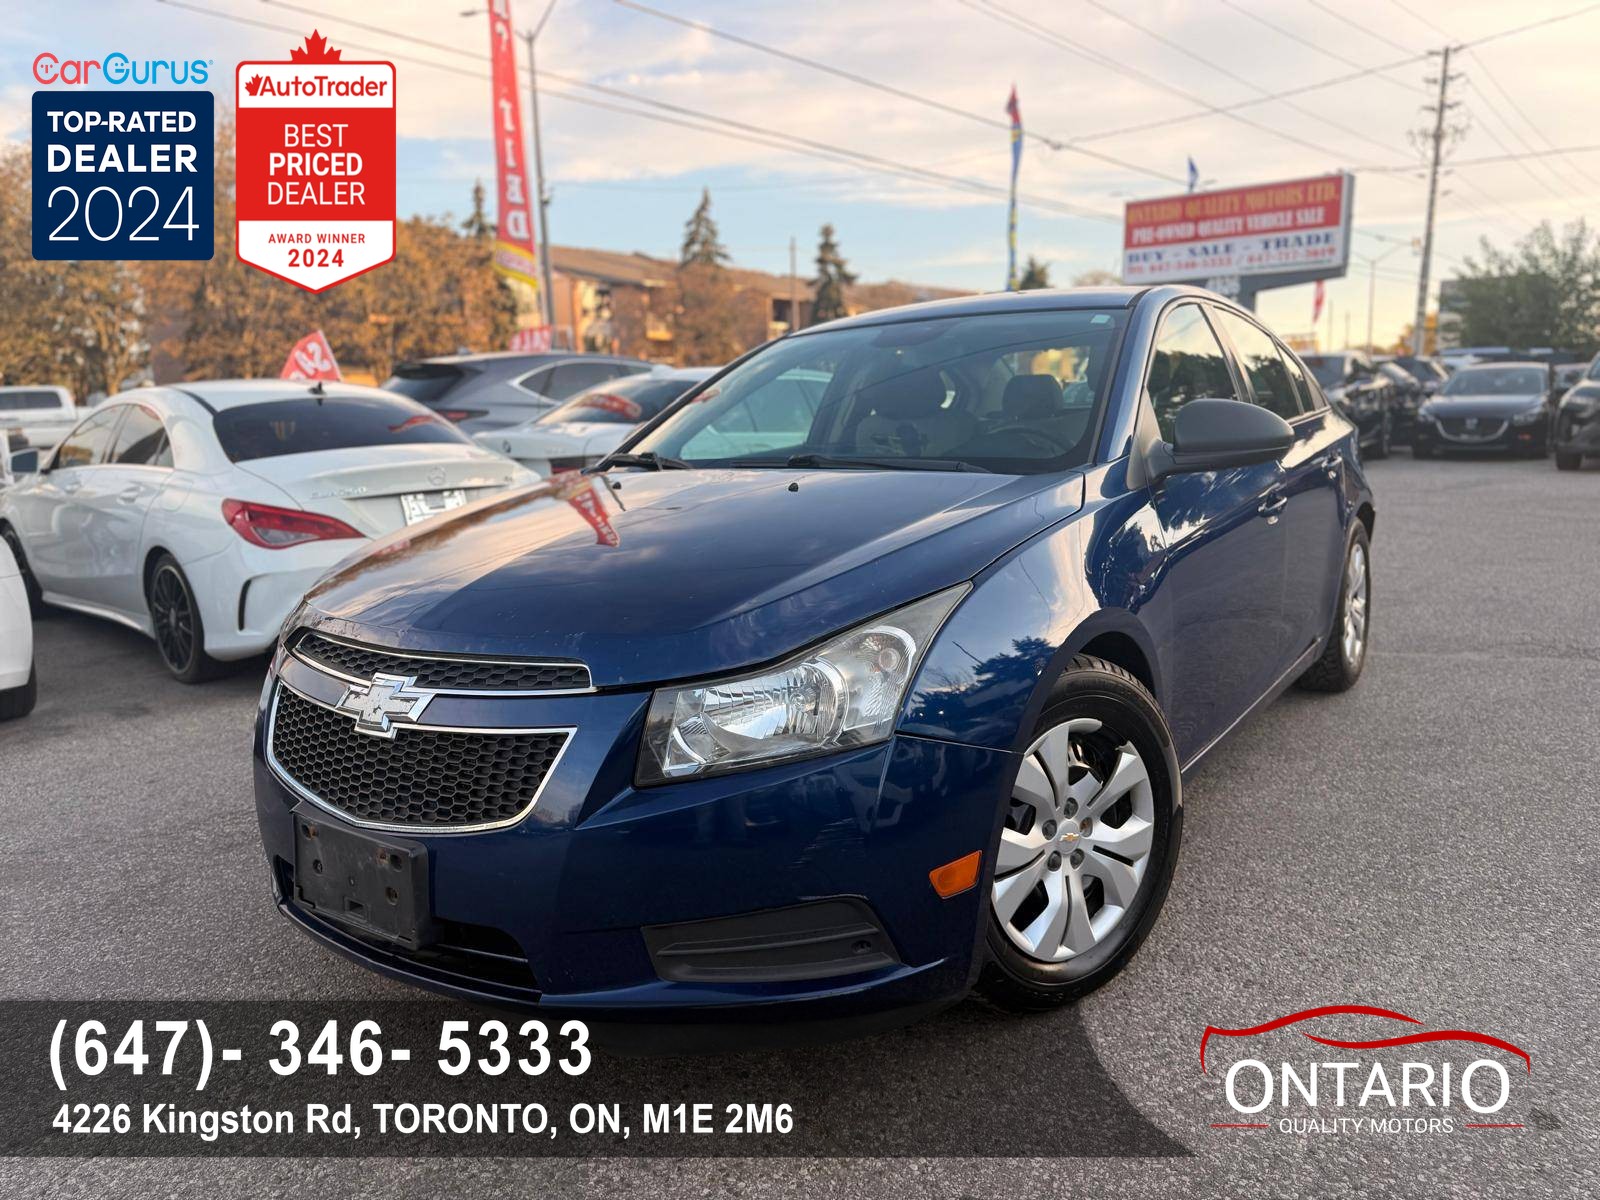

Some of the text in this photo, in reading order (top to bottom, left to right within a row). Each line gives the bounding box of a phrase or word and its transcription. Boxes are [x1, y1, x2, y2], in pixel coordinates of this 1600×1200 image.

[1296, 206, 1325, 226] SALE
[1127, 250, 1167, 263] BUY
[1188, 244, 1235, 257] SALE
[1259, 232, 1335, 250] TRADE
